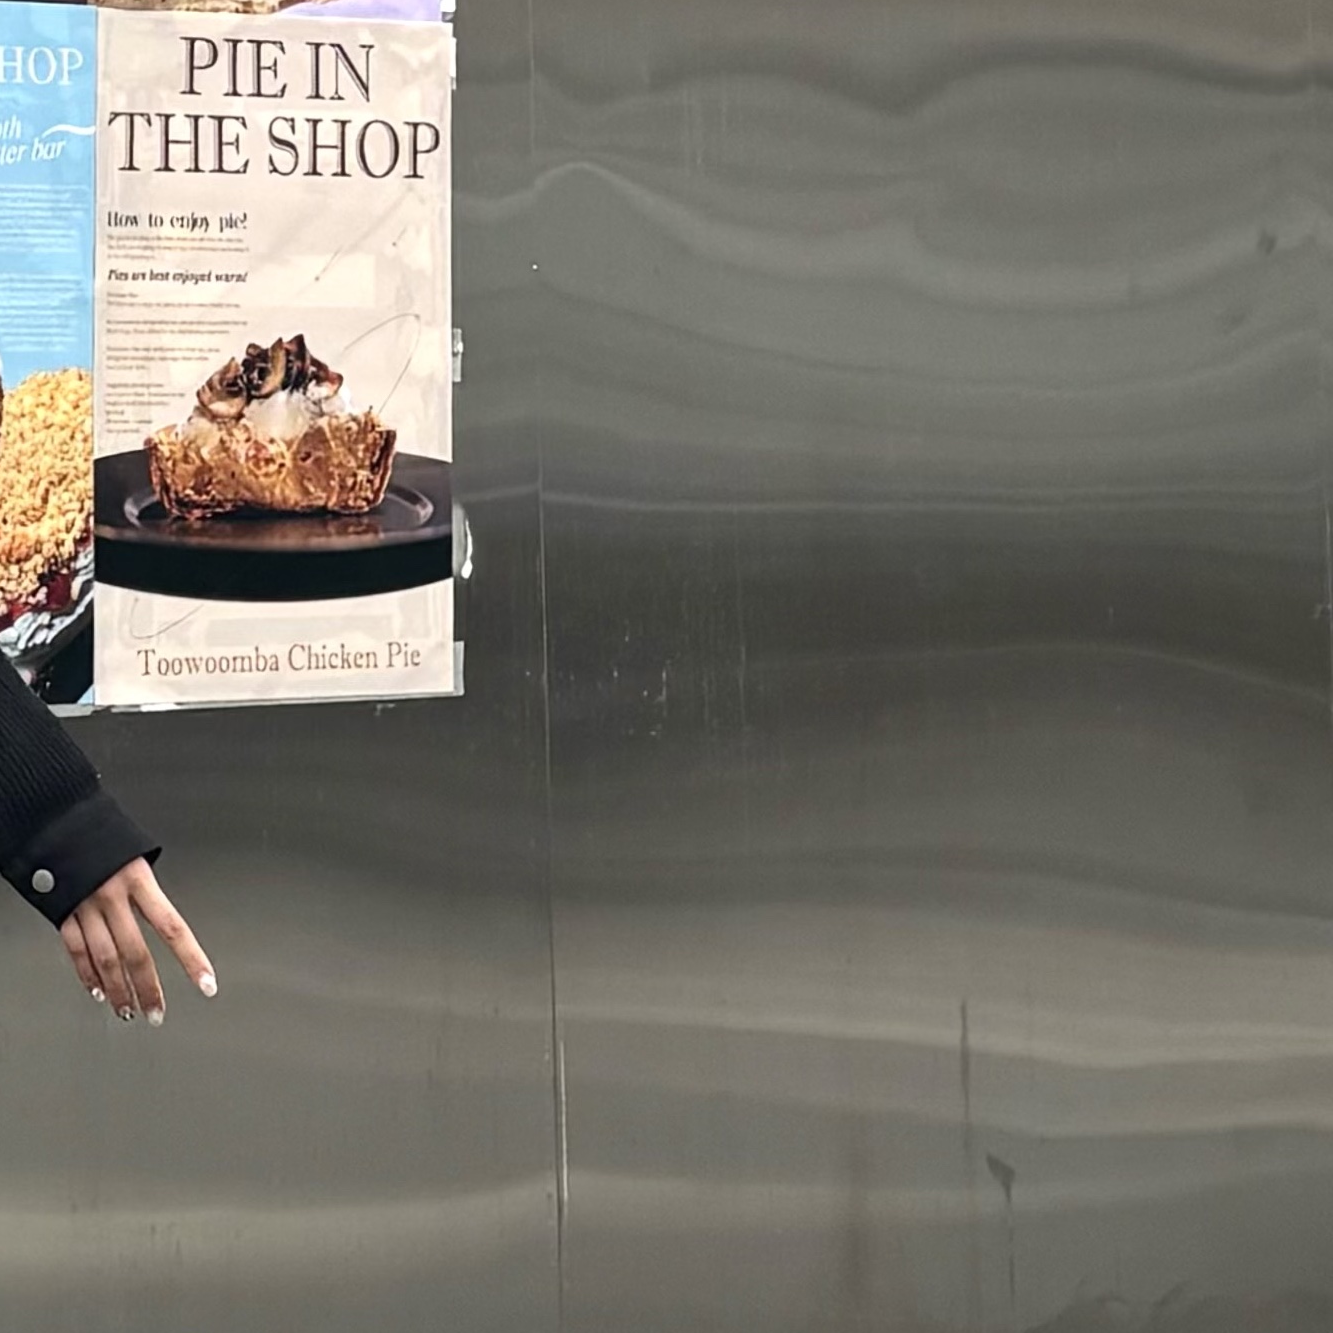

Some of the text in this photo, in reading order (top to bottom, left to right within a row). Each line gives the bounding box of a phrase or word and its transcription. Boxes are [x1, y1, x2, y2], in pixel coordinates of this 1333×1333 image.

[179, 36, 375, 103] PIE IN
[31, 138, 66, 162] bar
[108, 112, 441, 179] THE SHOP
[148, 214, 164, 227] to
[136, 641, 422, 677] Toowoomba Chicken Pie
